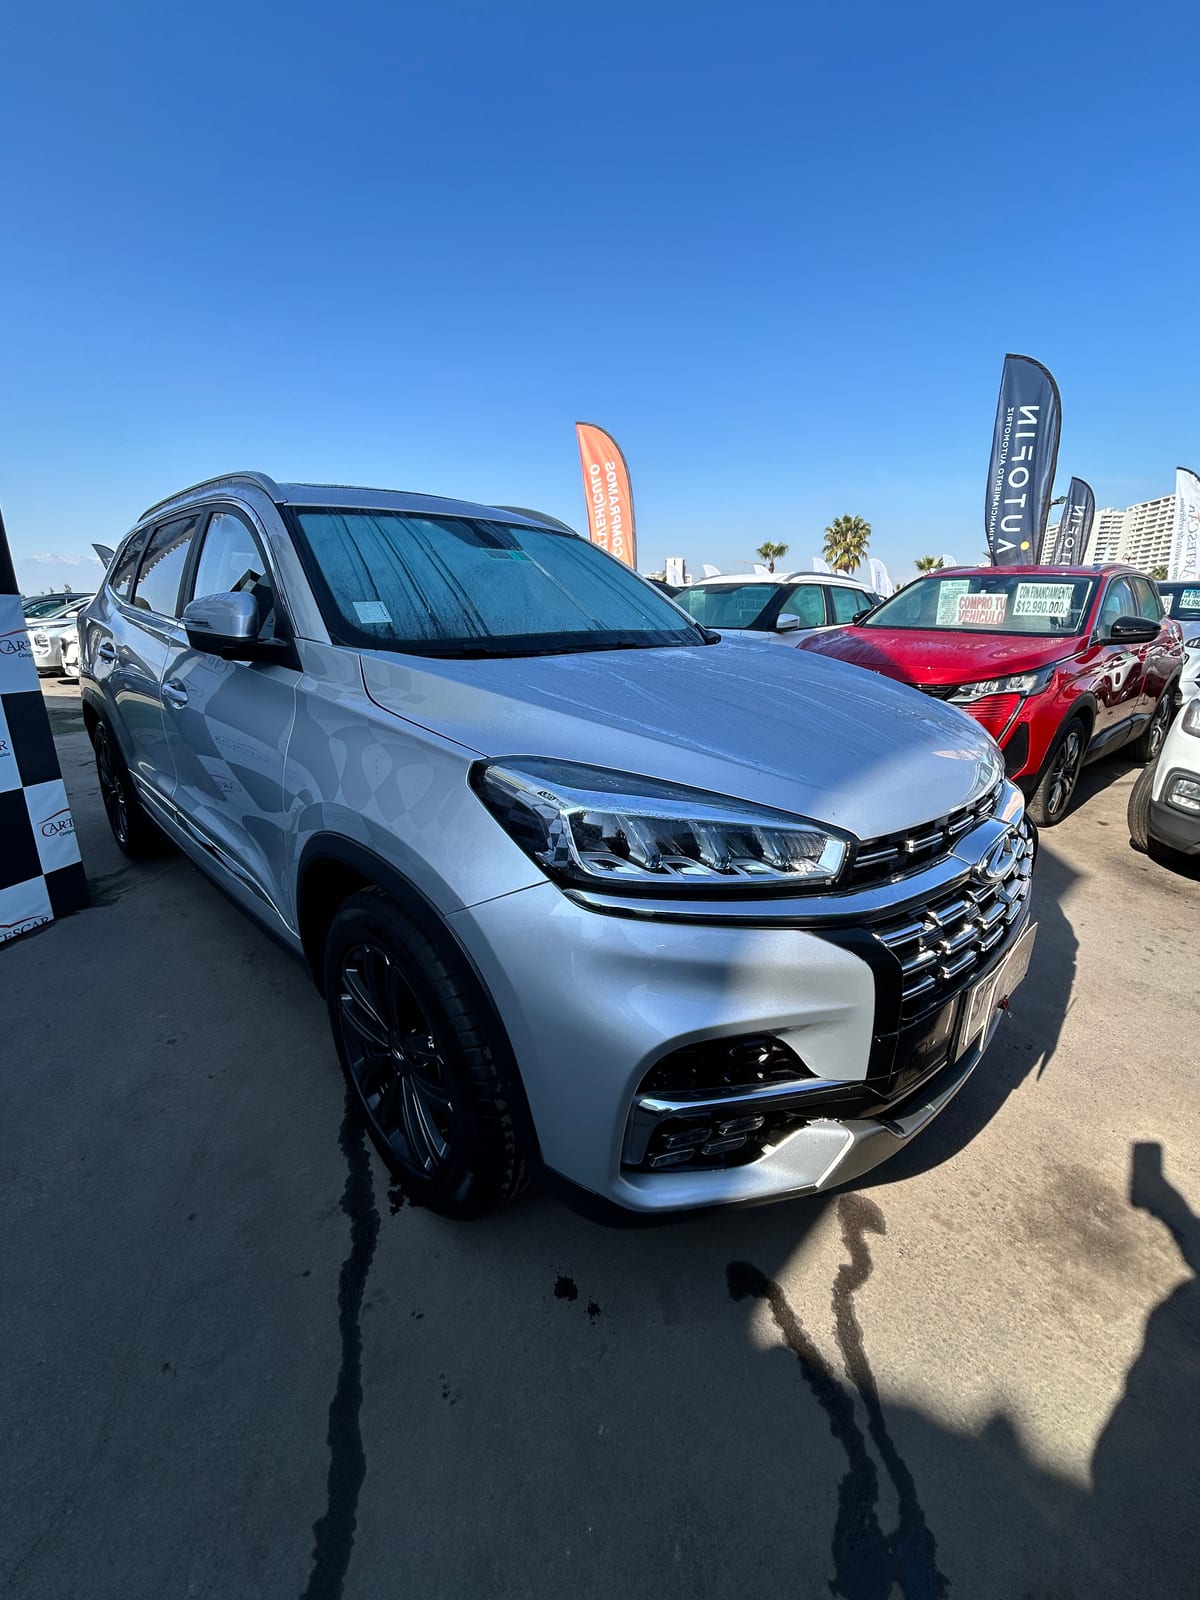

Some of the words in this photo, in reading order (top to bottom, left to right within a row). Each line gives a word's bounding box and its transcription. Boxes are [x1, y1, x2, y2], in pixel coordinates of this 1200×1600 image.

[958, 596, 993, 610] COMPRO
[994, 596, 1007, 610] TU
[958, 609, 1005, 624] VEHICULO
